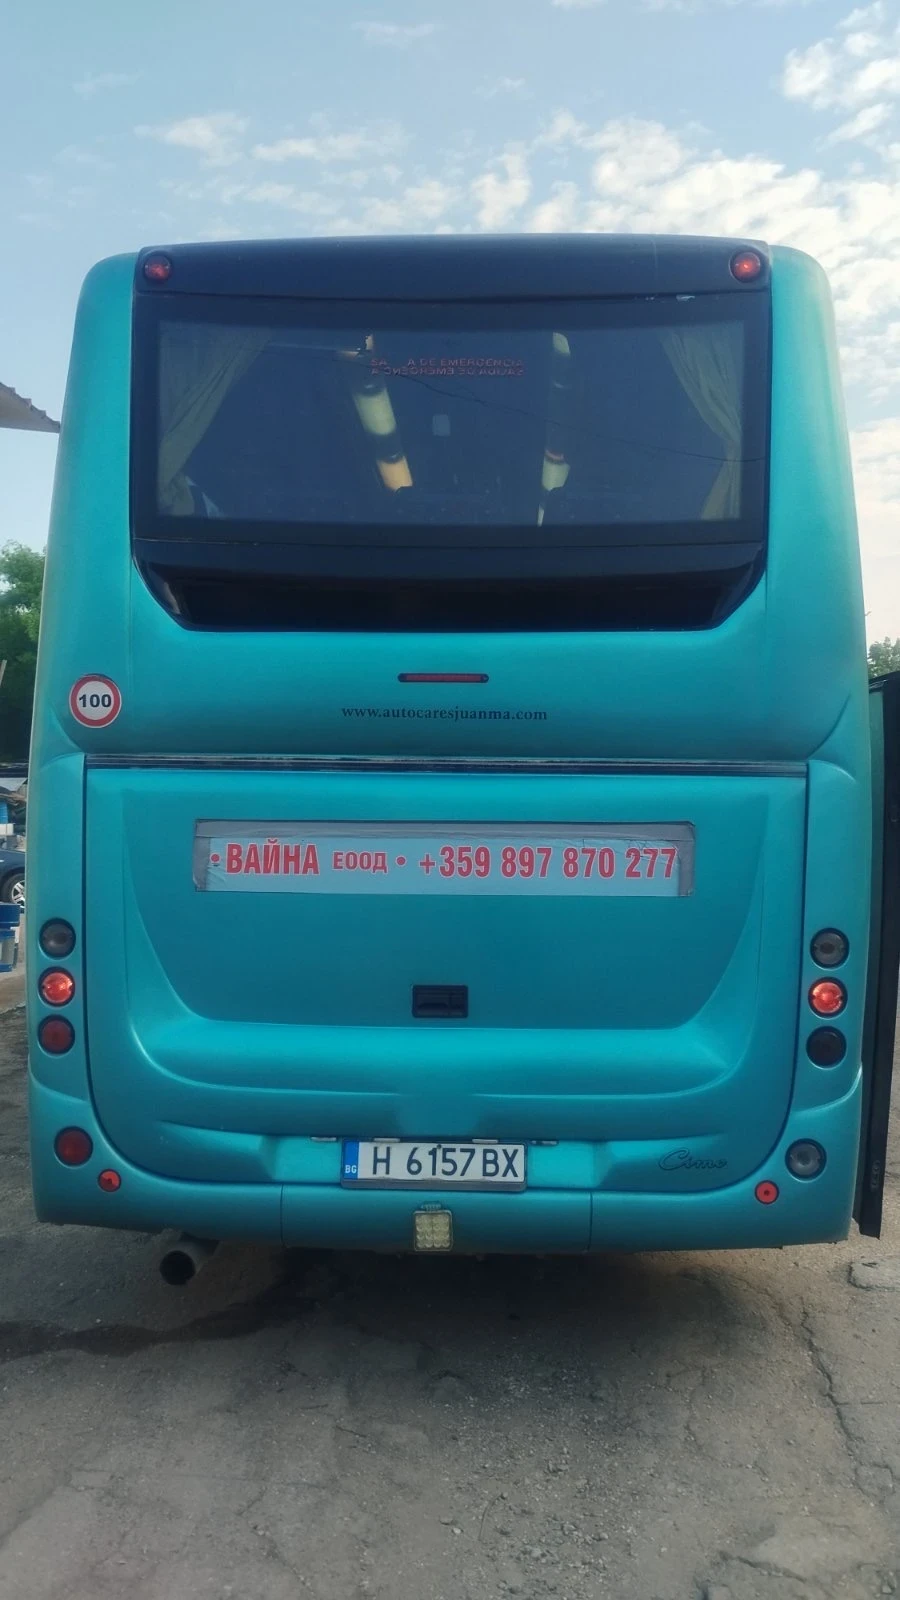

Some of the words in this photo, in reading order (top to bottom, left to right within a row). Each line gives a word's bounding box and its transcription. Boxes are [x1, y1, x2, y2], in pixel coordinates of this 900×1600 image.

[419, 358, 437, 367] DE
[440, 357, 524, 367] EMERGENCIA
[79, 694, 112, 708] 100
[341, 706, 548, 722] www.autocaresjuanma.com
[226, 838, 320, 875] ВАЙНА
[332, 851, 388, 874] ЕООД
[418, 845, 491, 879] +359
[501, 846, 552, 879] 897
[562, 847, 616, 879] 870
[624, 847, 677, 879] 277
[344, 1164, 357, 1174] BG
